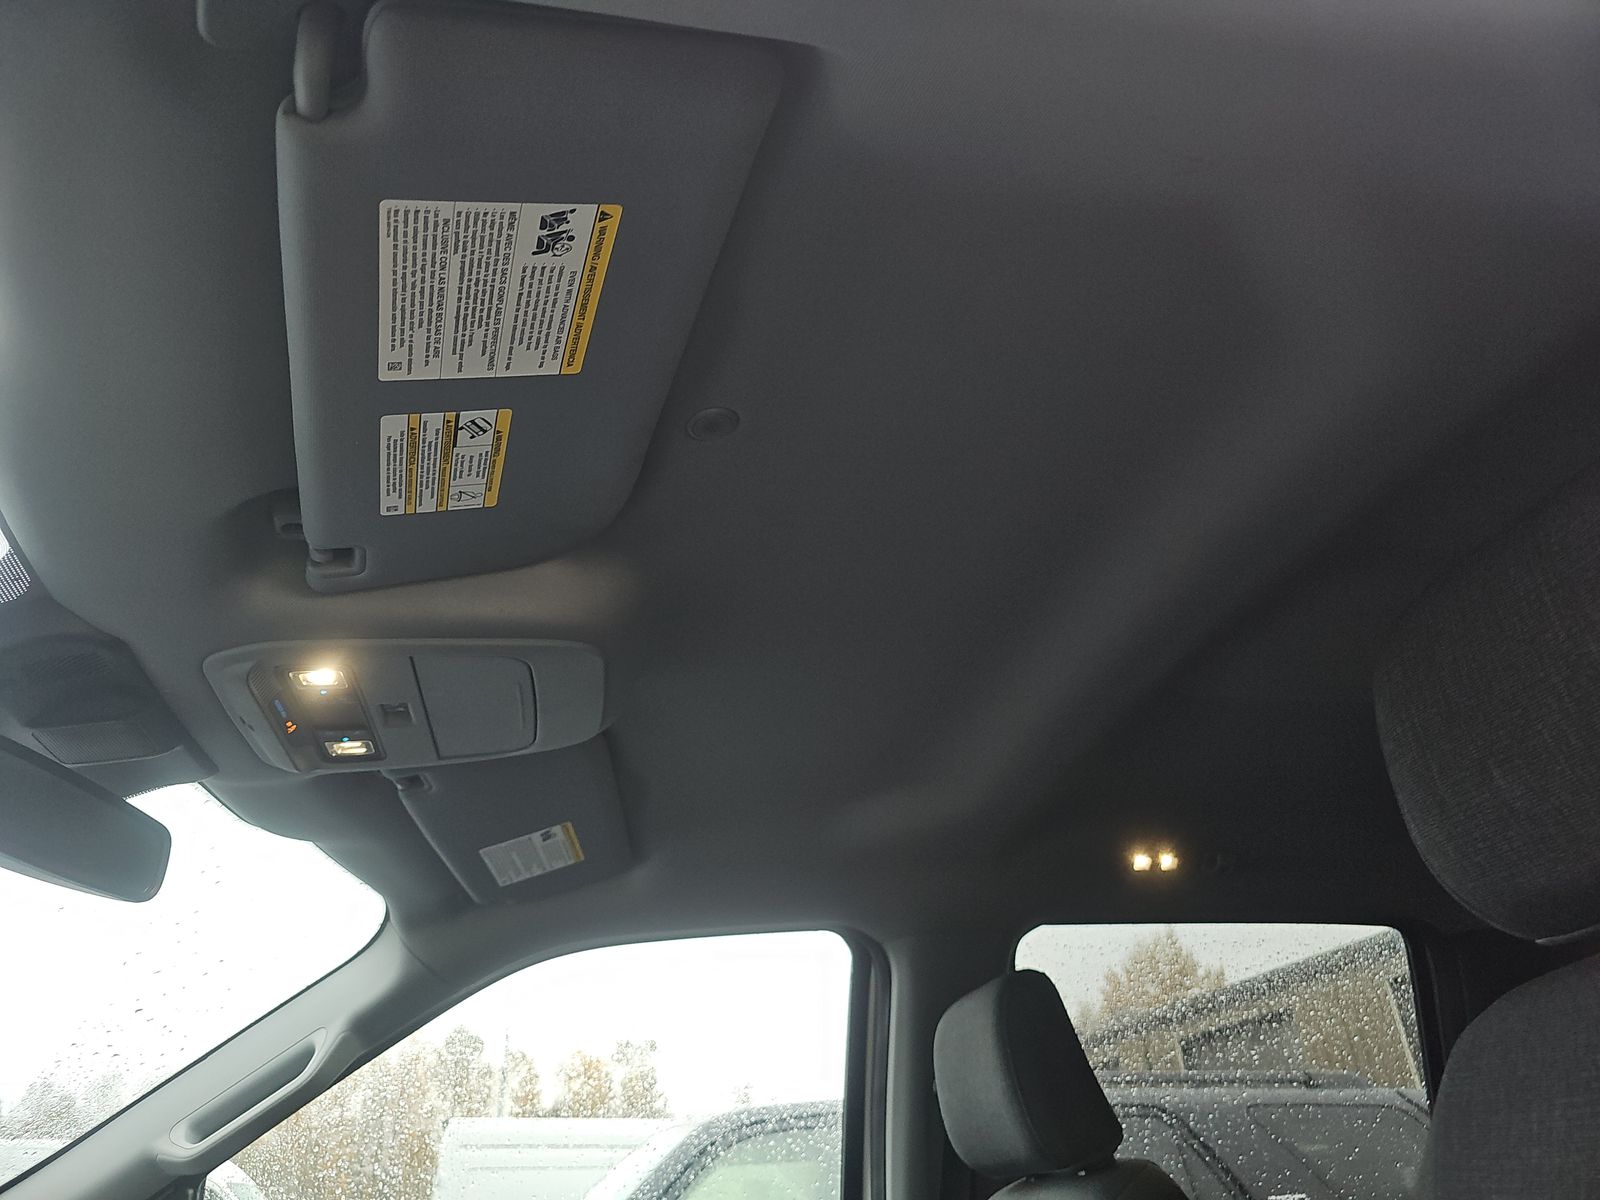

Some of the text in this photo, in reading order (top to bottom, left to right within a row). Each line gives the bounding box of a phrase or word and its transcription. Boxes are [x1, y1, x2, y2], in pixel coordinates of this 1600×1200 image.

[440, 218, 450, 255] INCLUSIVE
[504, 233, 513, 251] AVEC
[439, 256, 447, 271] CON
[501, 252, 510, 266] DES
[437, 272, 446, 285] LAS
[499, 267, 508, 284] SACS
[436, 286, 445, 311] NUEVAS
[493, 286, 505, 326] GONFLABLES
[434, 312, 443, 336] BOLSAS
[556, 304, 569, 334] ADVANCED
